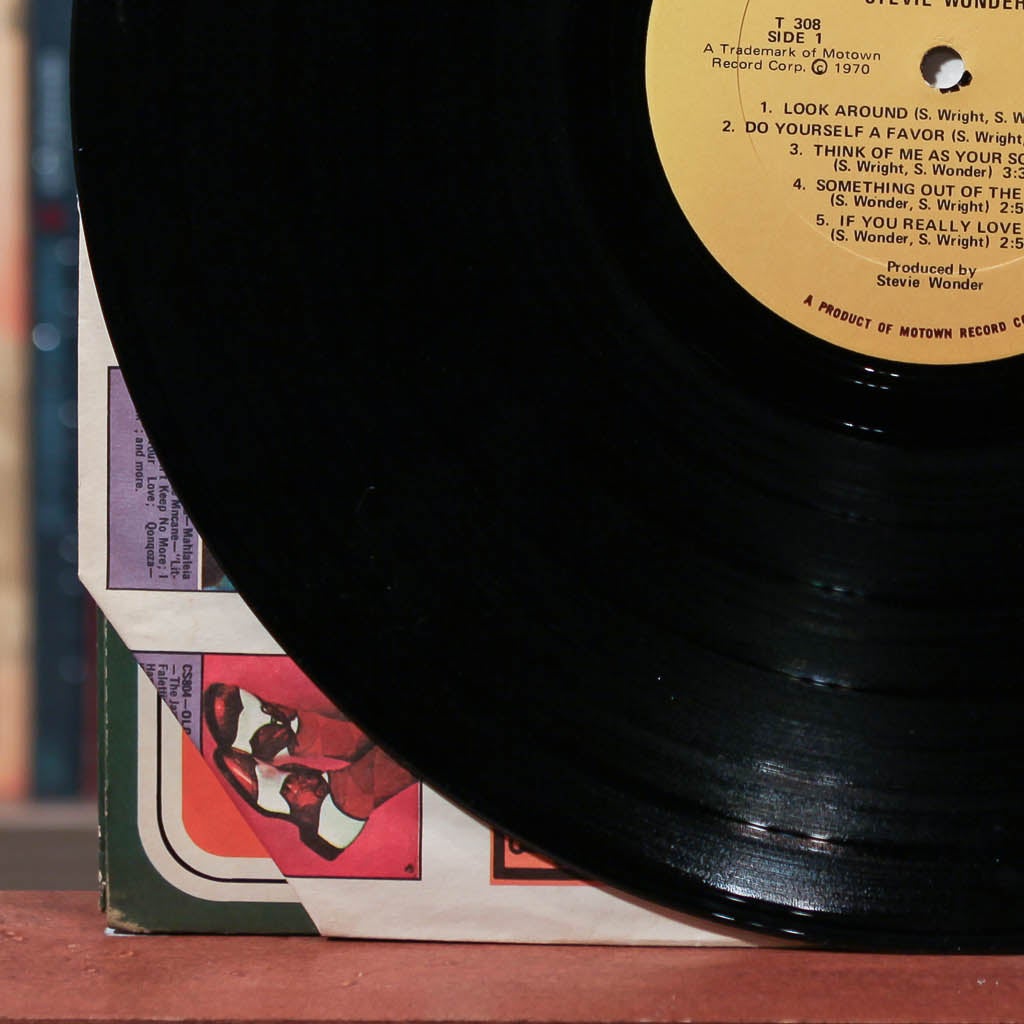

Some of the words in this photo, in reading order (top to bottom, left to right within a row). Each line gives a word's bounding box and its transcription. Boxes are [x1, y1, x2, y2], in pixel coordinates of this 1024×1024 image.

[775, 17, 785, 29] T
[793, 17, 821, 31] 308
[767, 31, 805, 44] SIDE
[815, 32, 821, 44] 1
[703, 43, 714, 54] A
[719, 43, 796, 58] Trademark
[802, 47, 817, 58] of
[822, 48, 881, 61] Motown
[712, 57, 763, 74] Record
[768, 60, 806, 74] Corp.
[835, 63, 870, 75] 1970
[761, 101, 772, 114] 1.
[784, 102, 829, 116] LOOK
[834, 104, 908, 119] AROUND
[914, 106, 932, 121] (S.
[937, 108, 989, 125] Wright,
[994, 111, 1007, 124] S.
[722, 120, 735, 132] 2.
[745, 121, 769, 134] DO
[775, 122, 864, 138] YOURSELF
[868, 126, 881, 139] A
[886, 127, 945, 142] FAVOR
[951, 129, 969, 143] (S.
[789, 143, 803, 156] 3.
[813, 144, 866, 159] THINK
[871, 146, 894, 159] OF
[899, 148, 923, 161] ME
[928, 149, 950, 162] AS
[955, 150, 1002, 165] YOUR
[833, 158, 851, 173] (S.
[856, 160, 908, 177] Wright,
[913, 162, 927, 175] S.
[932, 163, 992, 179] Wonder)
[793, 178, 806, 190] 4.
[816, 179, 915, 195] SOMETHING
[921, 184, 956, 197] OUT
[960, 185, 983, 198] OF
[988, 186, 1022, 200] THE
[830, 192, 848, 207] (S.
[854, 194, 913, 212] Wonder,
[918, 197, 931, 211] S.
[937, 198, 989, 215] Wright)
[816, 213, 829, 226] 5.
[840, 215, 855, 227] IF
[861, 216, 898, 230] YOU
[903, 217, 971, 233] REALLY
[977, 221, 1022, 235] LOVE
[831, 228, 848, 242] (S.
[854, 229, 913, 247] Wonder,
[918, 232, 931, 246] S.
[936, 233, 990, 250] Wright)
[887, 260, 954, 275] Produced
[958, 263, 977, 279] by
[876, 274, 920, 288] Stevie
[929, 276, 984, 291] Wonder
[804, 294, 813, 307] A
[818, 300, 871, 330] PRODUCT
[877, 322, 893, 335] OF
[900, 327, 952, 338] MOTOWN
[959, 321, 1006, 339] RECORD
[135, 437, 145, 457] and
[135, 461, 145, 492] more.
[145, 476, 158, 507] Love;
[157, 485, 170, 512] Keep
[158, 517, 169, 533] No
[158, 537, 169, 570] More;
